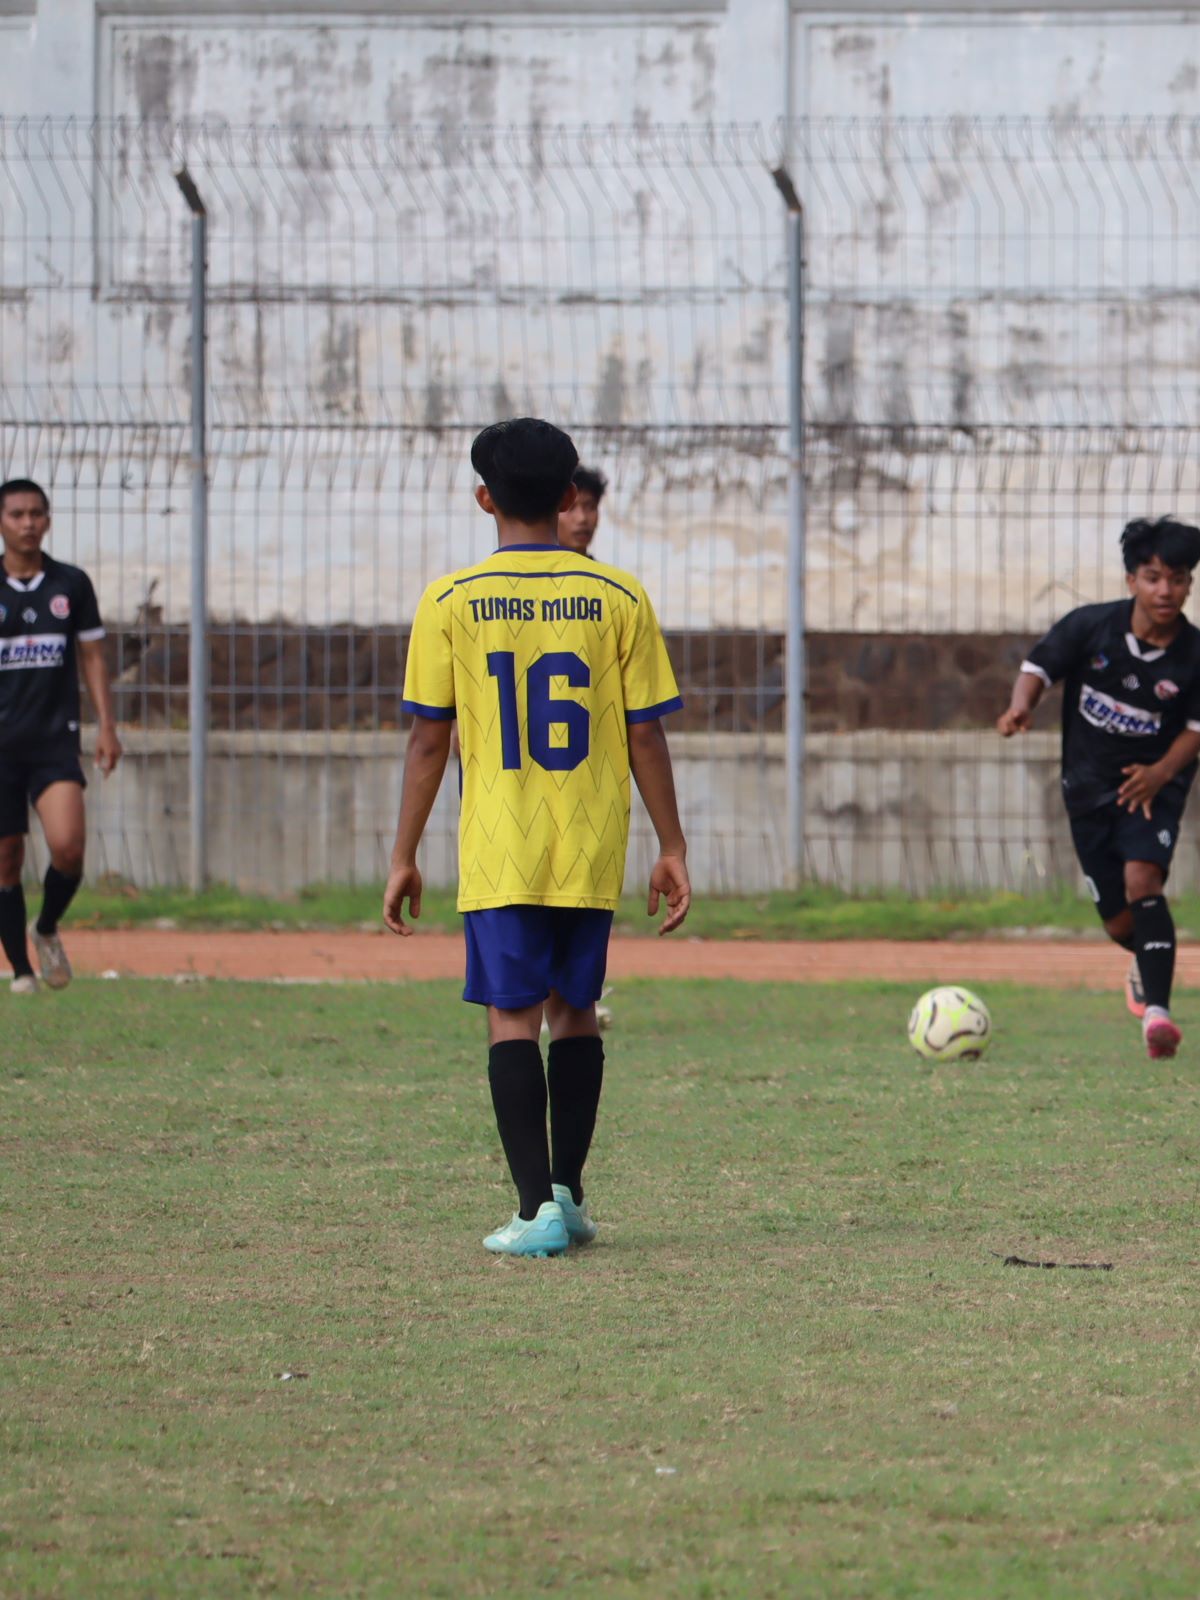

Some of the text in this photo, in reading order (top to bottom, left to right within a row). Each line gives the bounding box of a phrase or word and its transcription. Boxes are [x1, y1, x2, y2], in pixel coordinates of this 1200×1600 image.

[468, 596, 602, 623] TUNAS MUDA
[486, 651, 590, 771] 16
